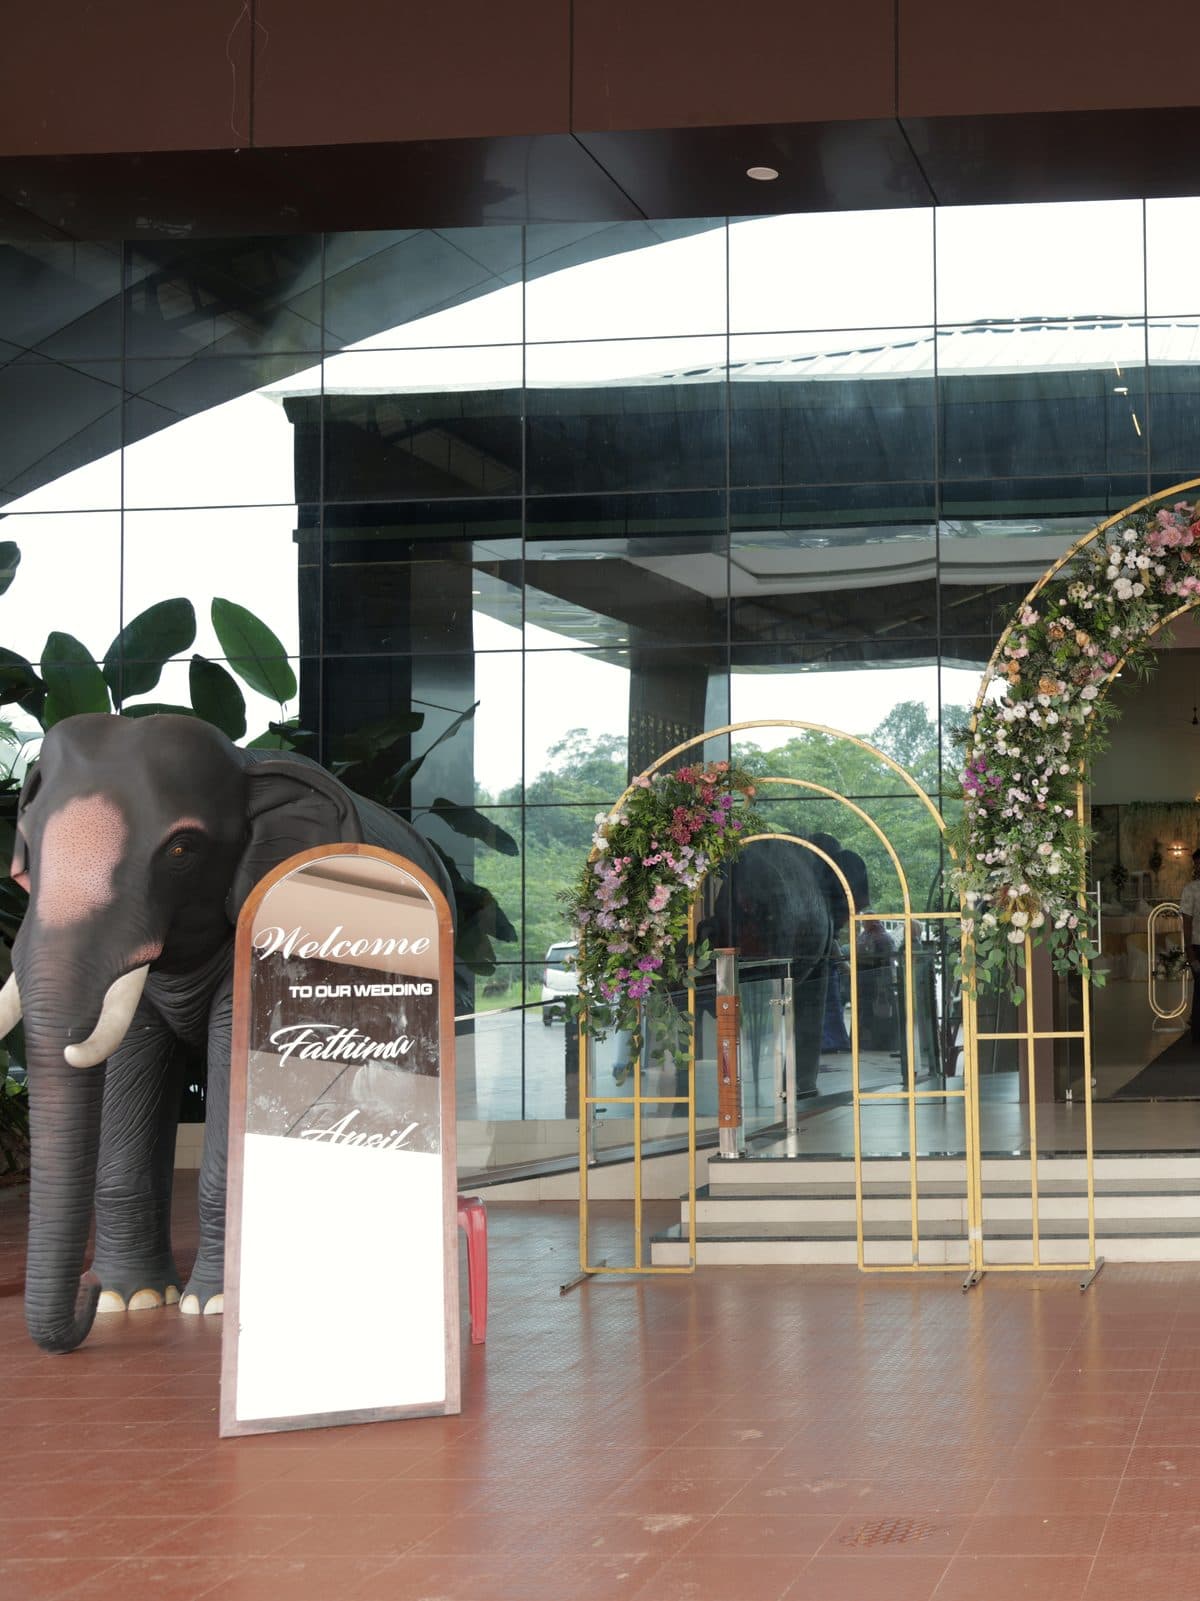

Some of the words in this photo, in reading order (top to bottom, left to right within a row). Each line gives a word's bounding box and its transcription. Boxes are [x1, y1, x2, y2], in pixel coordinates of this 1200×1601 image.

[252, 926, 431, 960] Welcome
[289, 985, 313, 998] TO
[315, 984, 351, 998] OUR
[353, 983, 433, 997] WEDDING
[270, 1024, 415, 1067] Fathima
